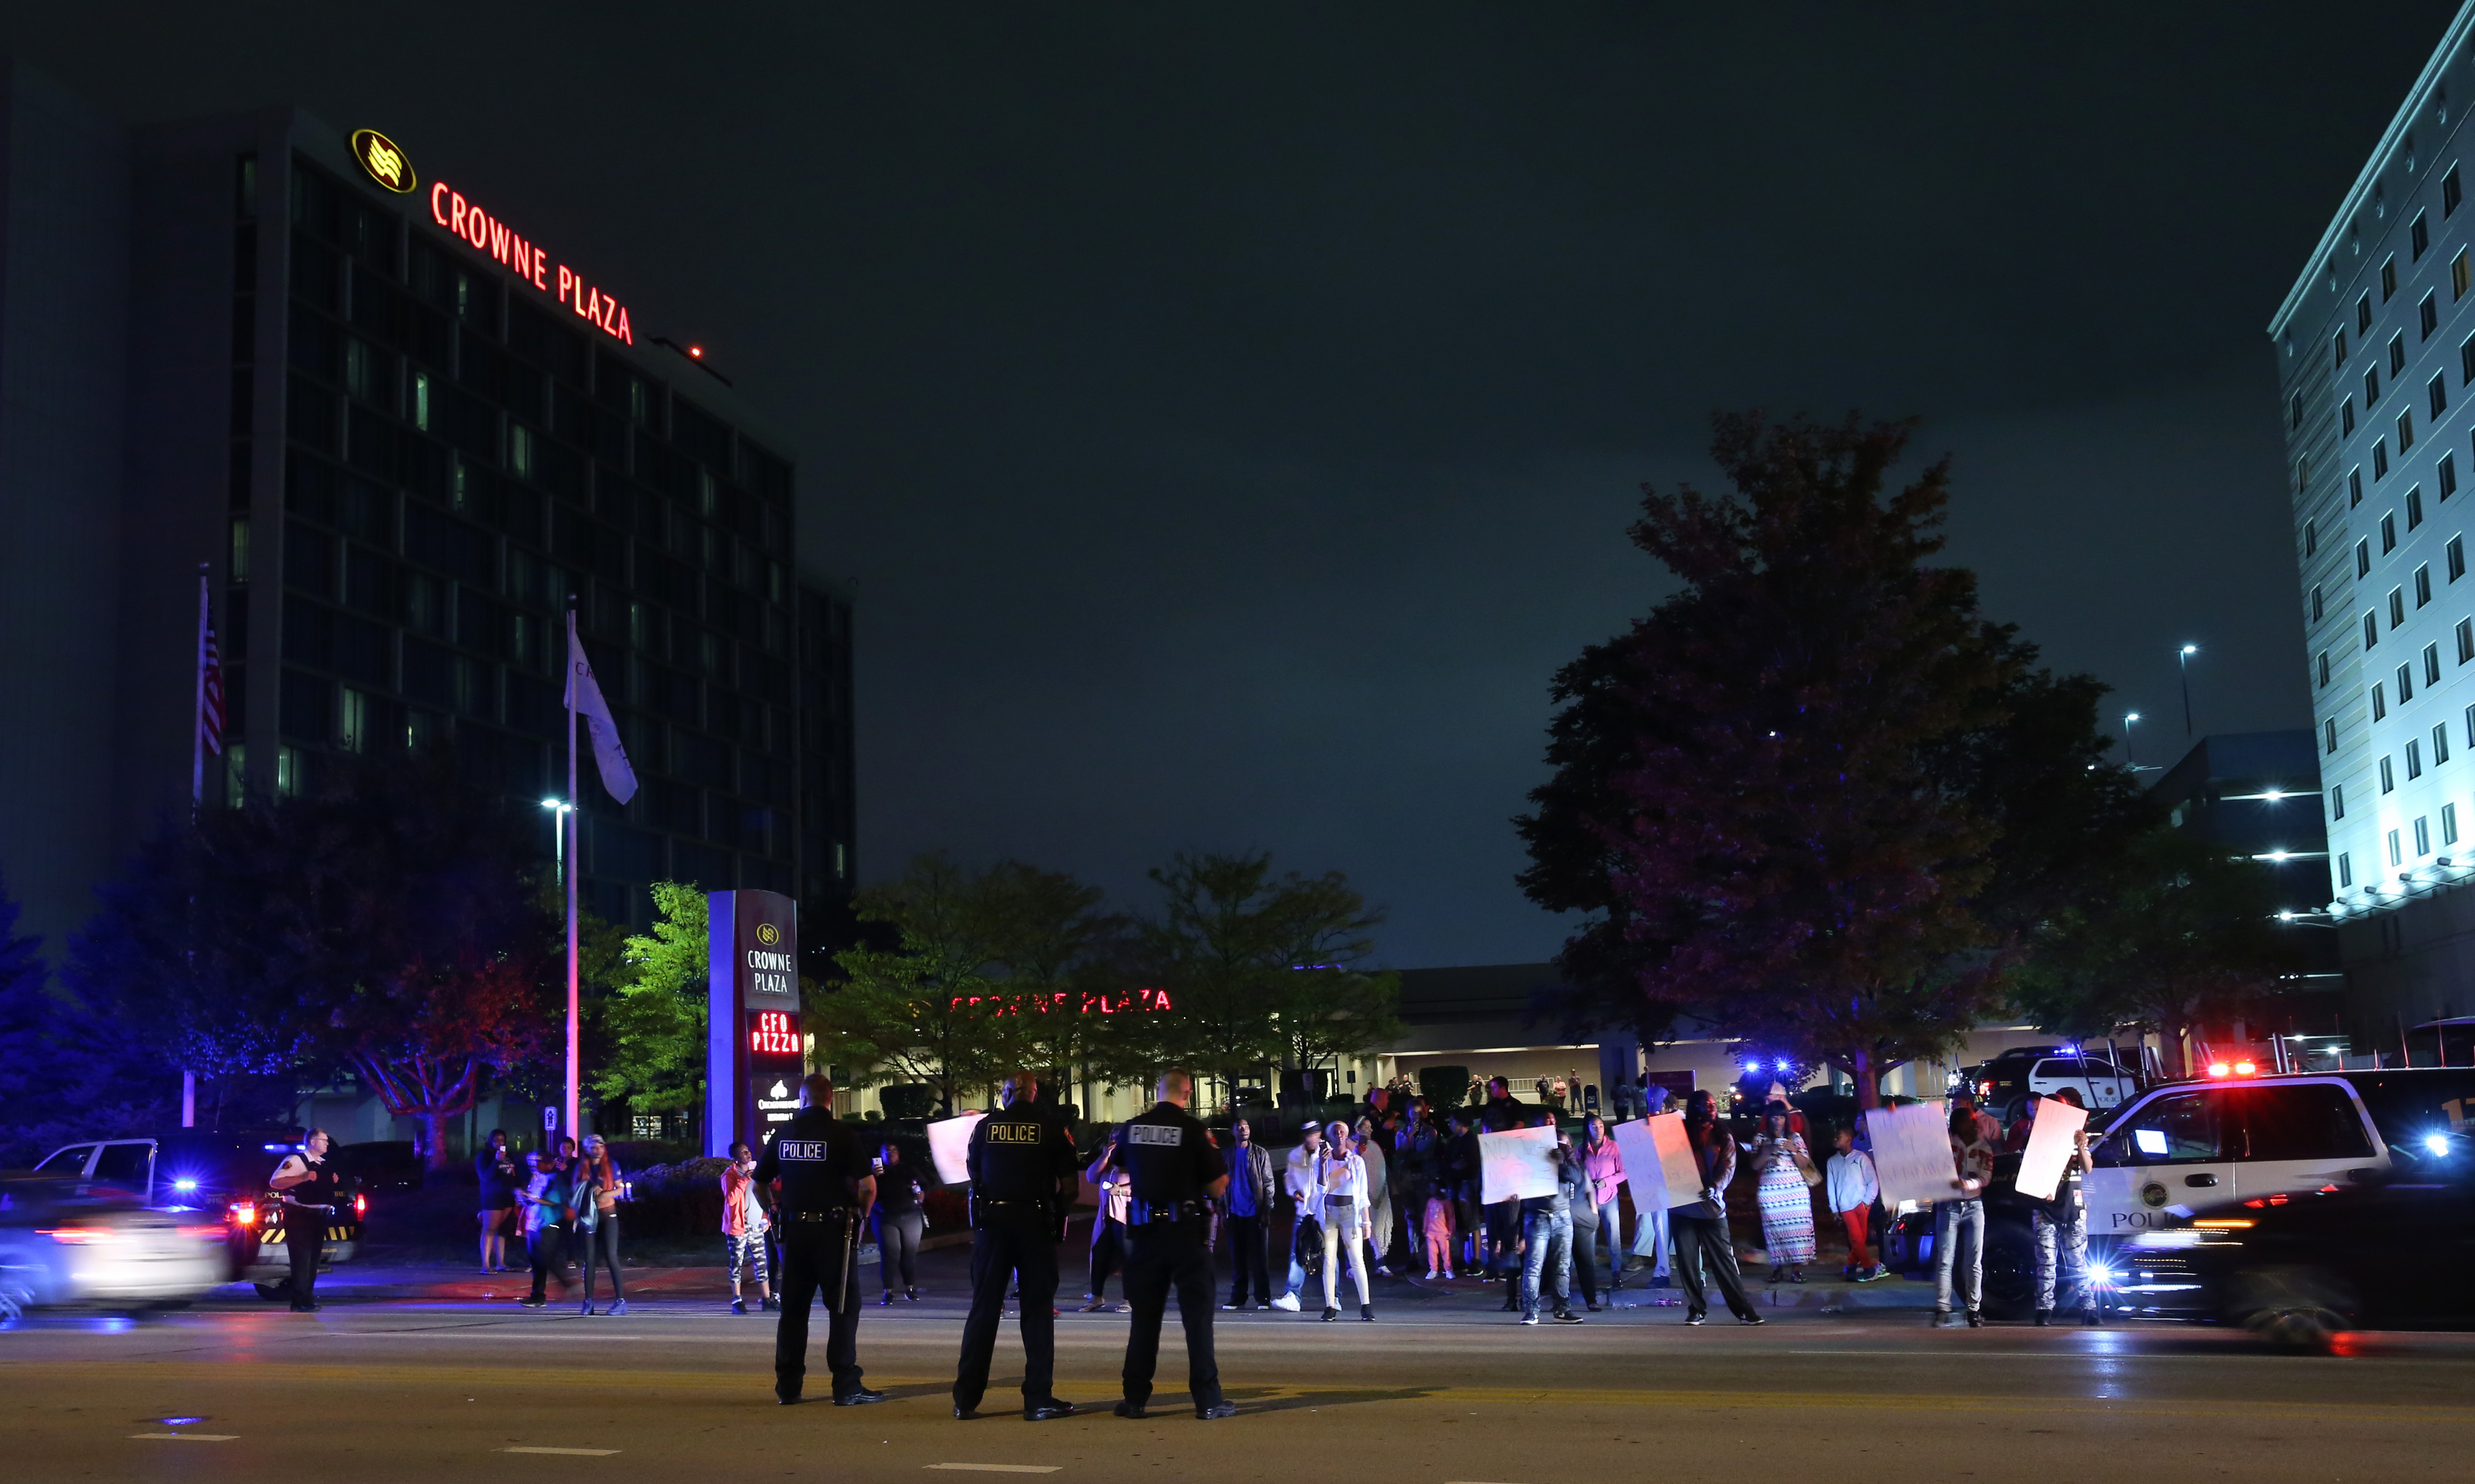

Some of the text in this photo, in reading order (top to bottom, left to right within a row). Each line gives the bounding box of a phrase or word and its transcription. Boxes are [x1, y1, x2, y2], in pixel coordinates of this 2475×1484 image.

[432, 182, 633, 345] CROWNE PLAZA
[748, 950, 791, 973] CROWNE
[754, 973, 788, 993] PLAZA
[761, 1012, 788, 1032] CFO
[752, 1031, 799, 1052] PIZZA
[991, 1124, 1036, 1141] POLICE
[1133, 1126, 1178, 1144] POLICE
[783, 1143, 822, 1158] POLICE
[1484, 1138, 1510, 1161] NO
